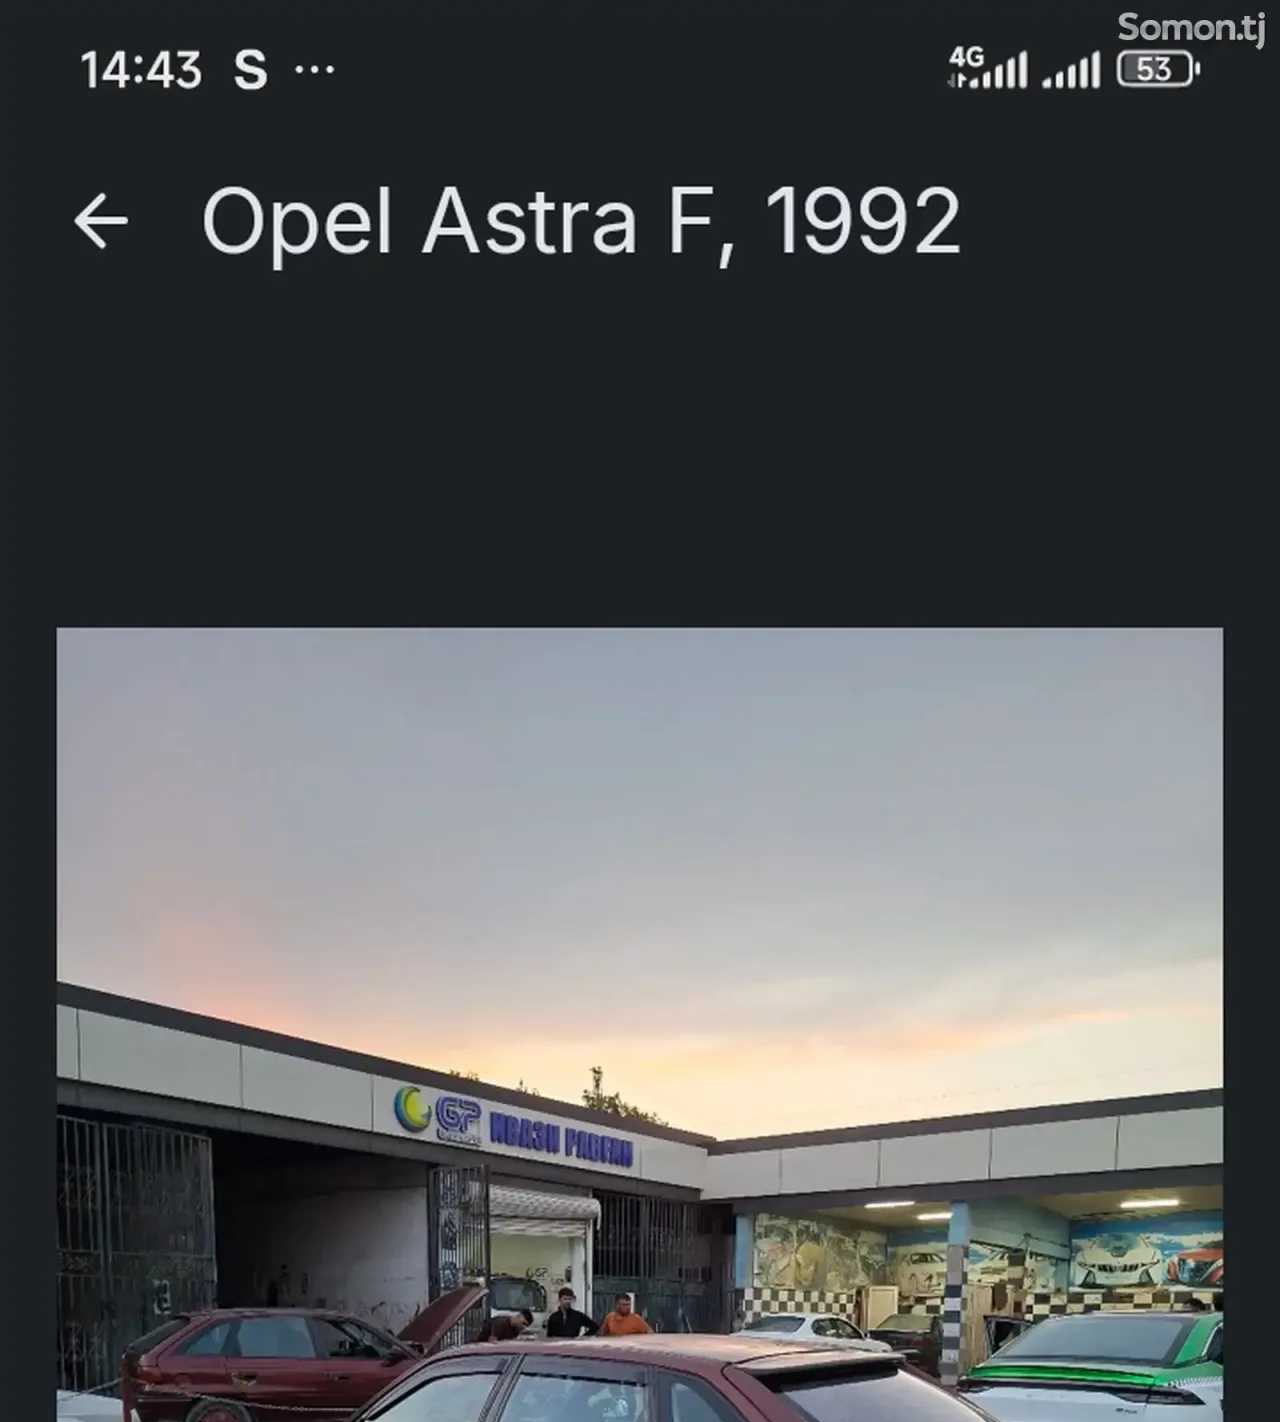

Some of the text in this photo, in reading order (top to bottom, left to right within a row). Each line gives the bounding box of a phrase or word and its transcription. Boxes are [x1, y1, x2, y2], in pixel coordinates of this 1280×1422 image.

[81, 48, 268, 90] 14:43 S
[948, 45, 985, 68] 4G
[1136, 55, 1173, 83] 53
[203, 185, 961, 272] Opel Astra F, 1992
